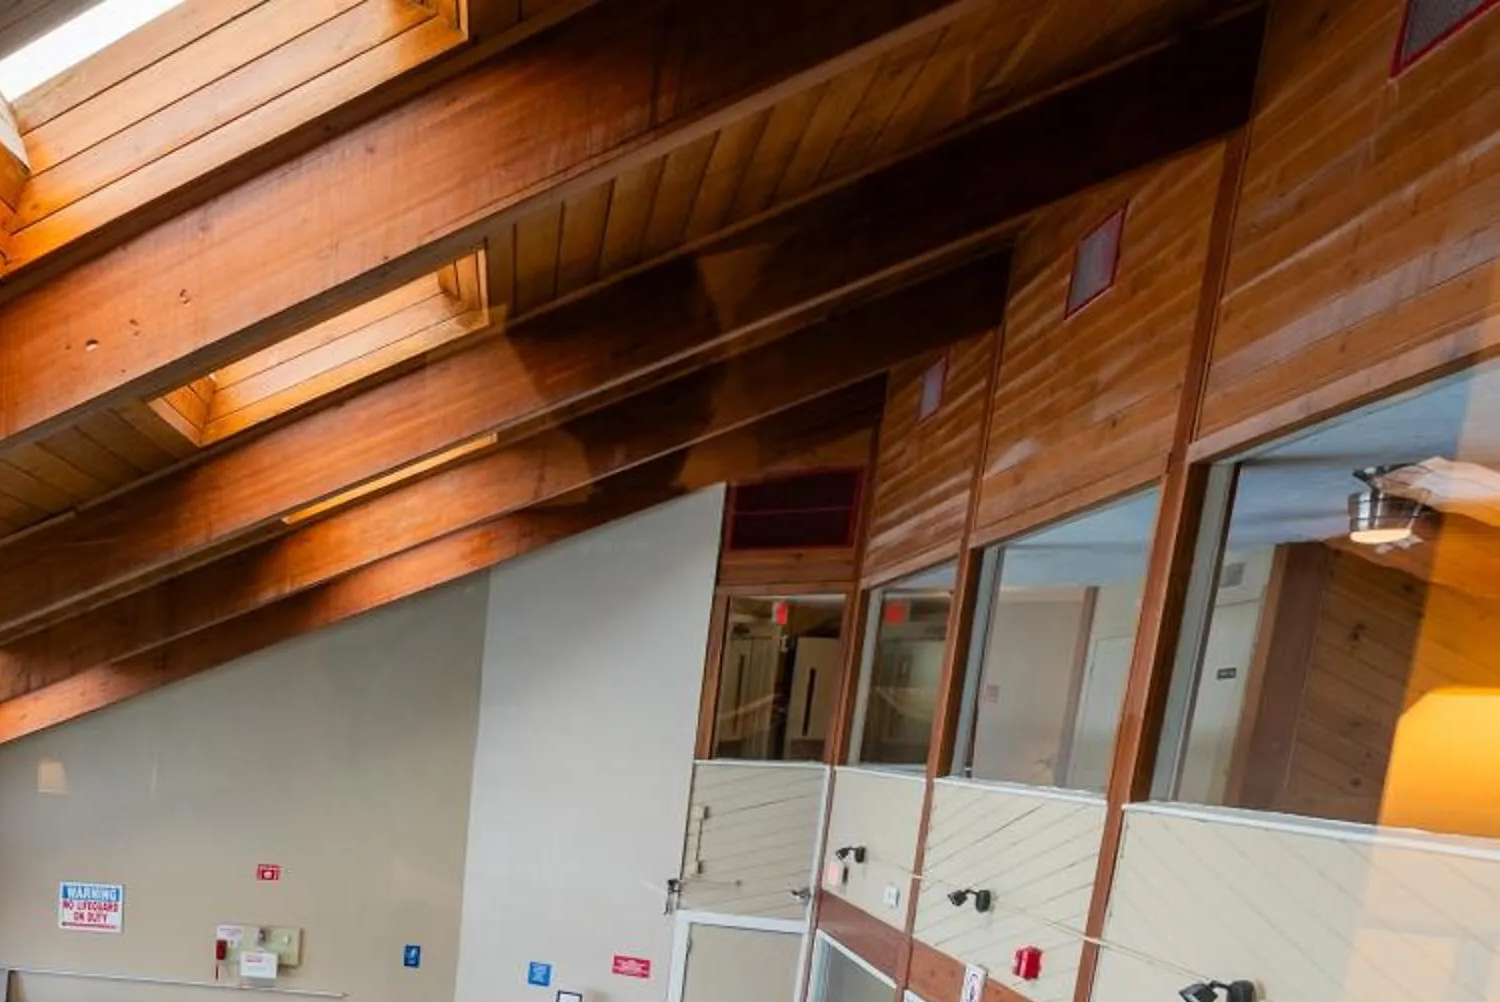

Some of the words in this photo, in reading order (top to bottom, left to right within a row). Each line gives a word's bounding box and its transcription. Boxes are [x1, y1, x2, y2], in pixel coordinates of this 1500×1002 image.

[67, 886, 117, 901] WARNING
[63, 901, 75, 911] NO
[76, 901, 119, 913] LIFEGUARD
[73, 911, 85, 921] ON
[87, 912, 107, 923] DUTY
